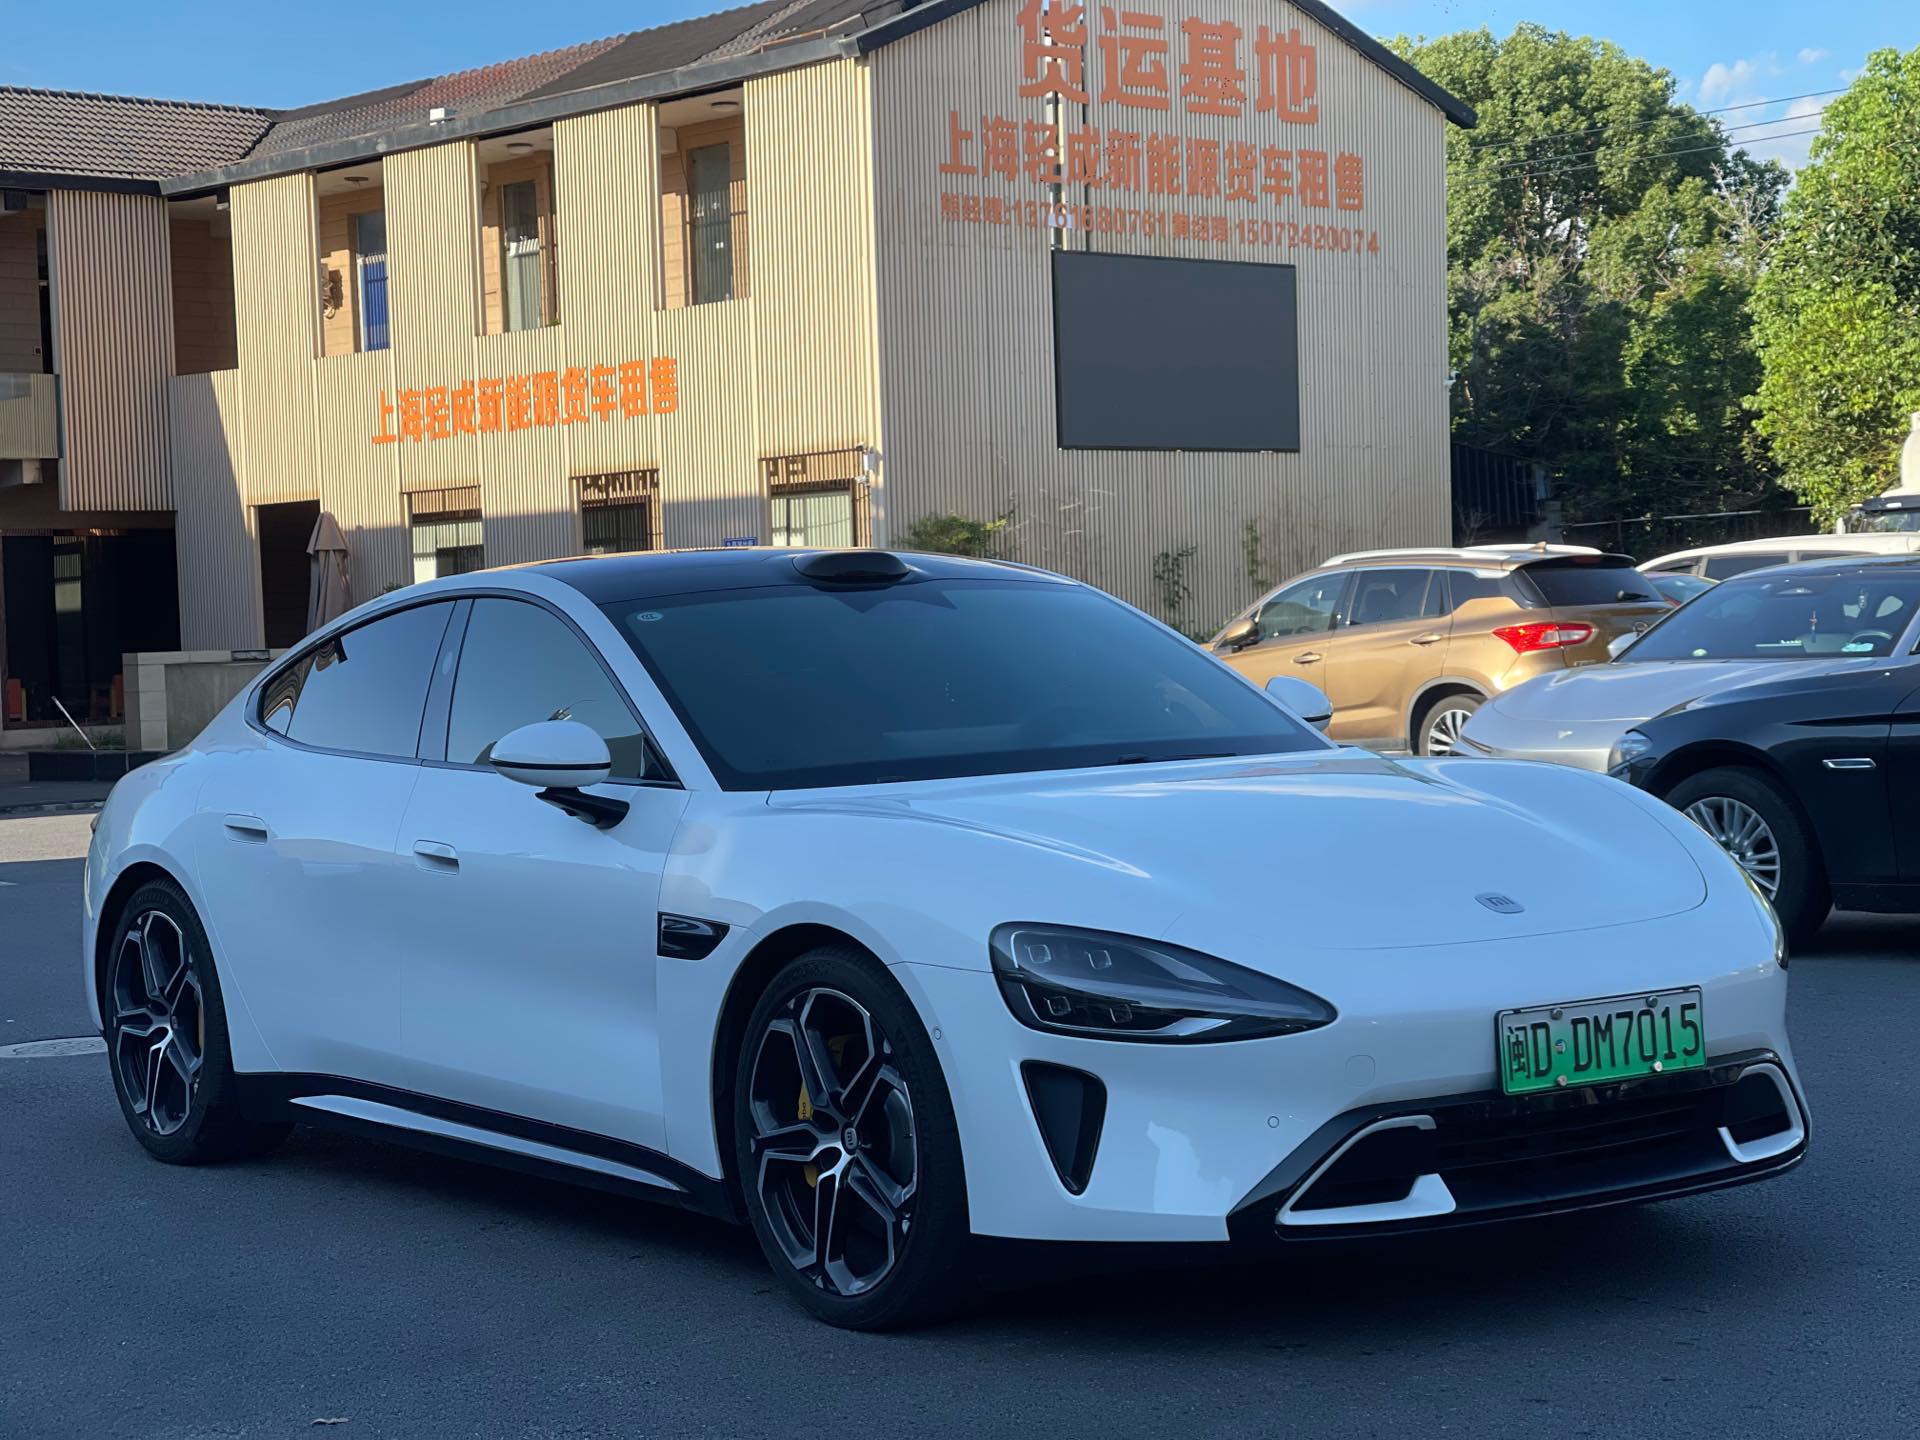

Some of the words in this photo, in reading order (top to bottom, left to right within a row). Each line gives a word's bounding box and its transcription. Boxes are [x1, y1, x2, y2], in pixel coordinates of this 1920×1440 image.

[1017, 0, 1318, 124] 货运基地
[939, 111, 1364, 211] 上海轻成新能源货车租售
[371, 356, 678, 446] 上海轻成新能源货车租售
